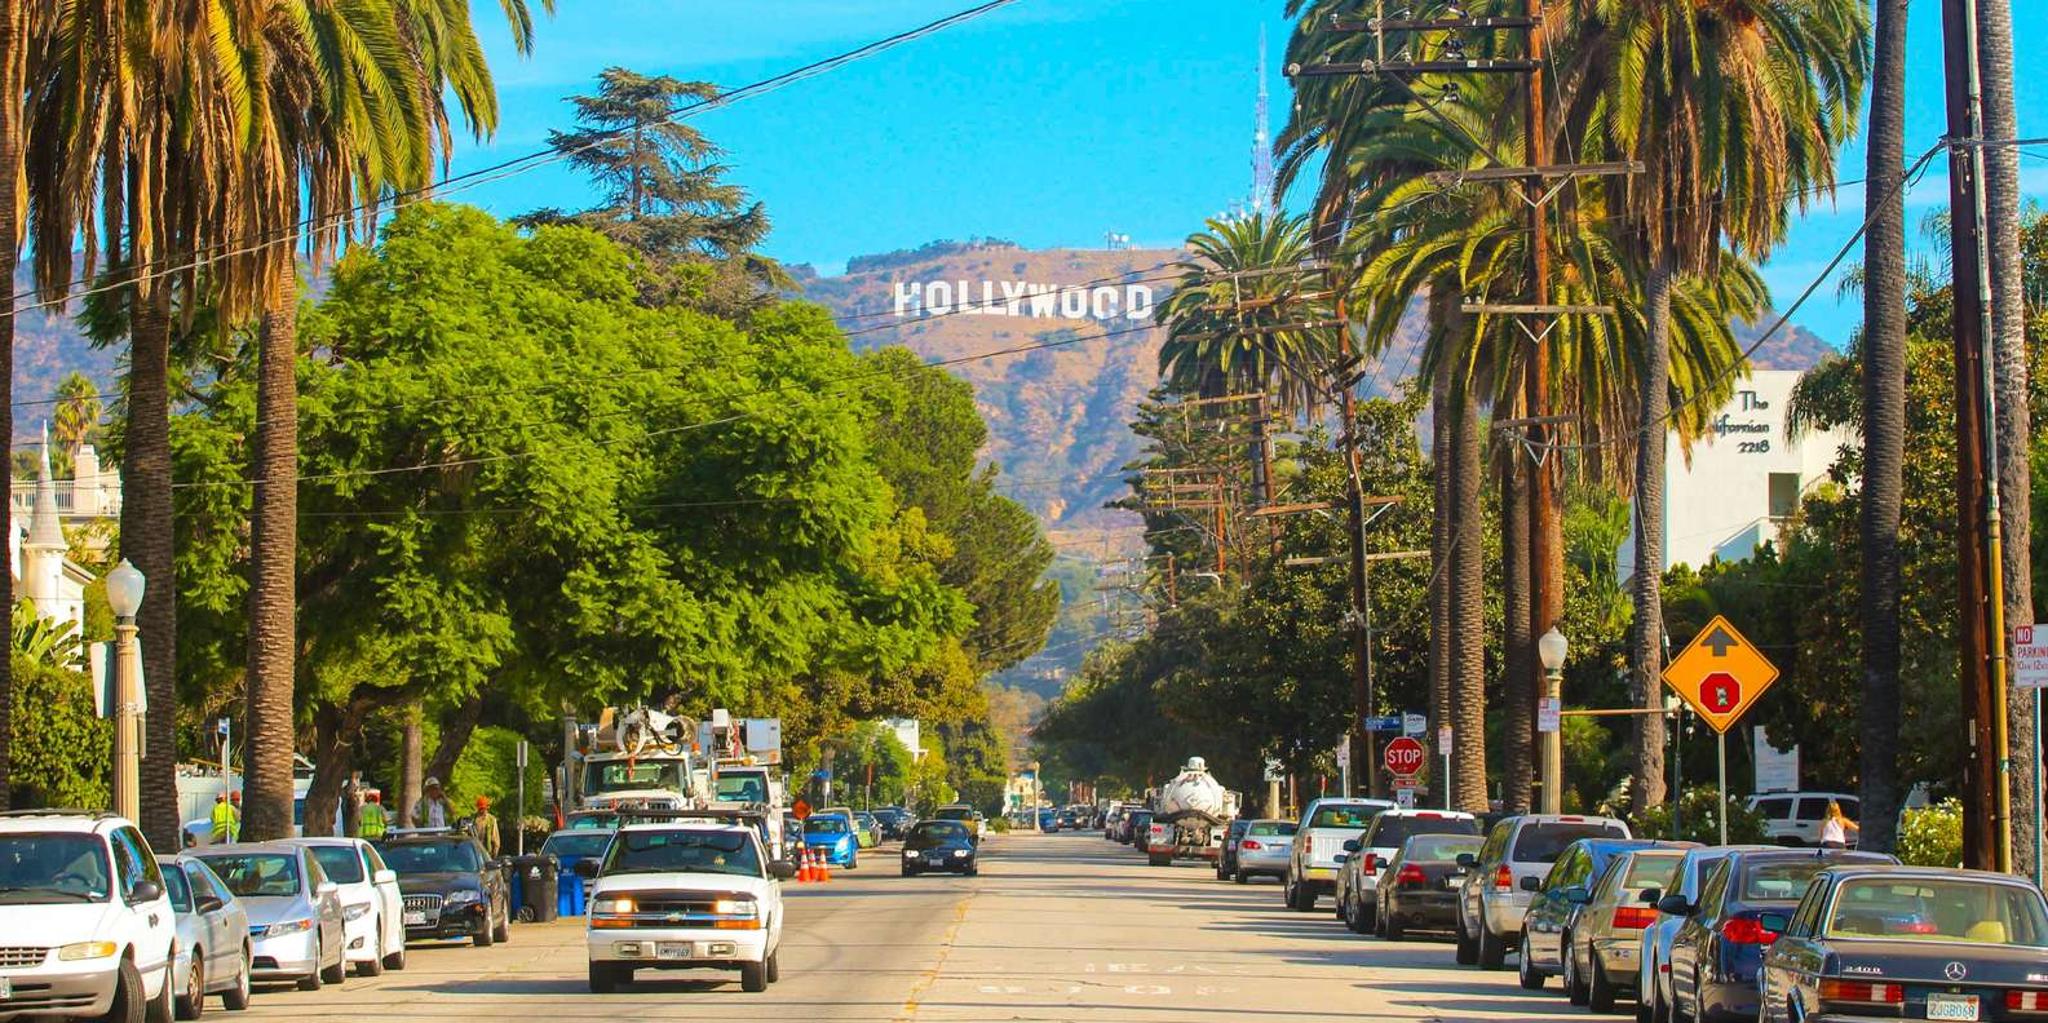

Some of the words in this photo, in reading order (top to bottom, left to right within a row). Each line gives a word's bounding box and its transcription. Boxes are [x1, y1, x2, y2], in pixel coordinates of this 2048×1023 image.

[894, 280, 1153, 320] HOLLYWOOD
[1738, 390, 1769, 412] The
[1737, 439, 1770, 454] 2218
[2016, 627, 2031, 643] NO
[1388, 749, 1421, 764] STOP
